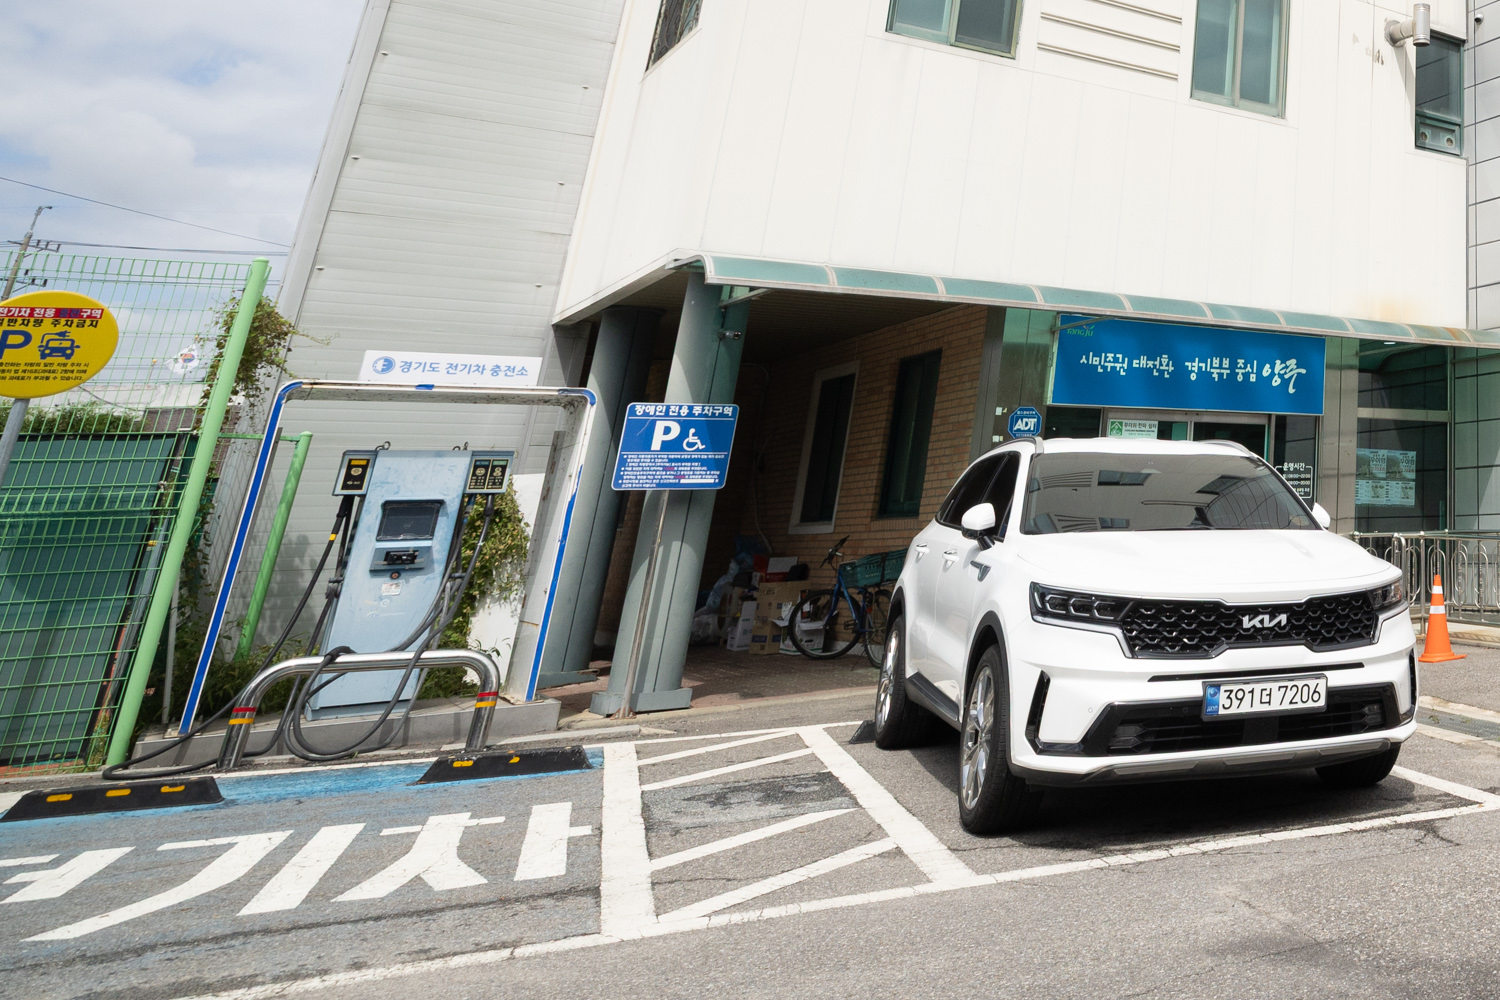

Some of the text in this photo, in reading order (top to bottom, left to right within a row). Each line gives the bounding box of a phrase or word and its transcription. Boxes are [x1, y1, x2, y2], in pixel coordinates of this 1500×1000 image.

[0, 308, 30, 317] 전기차
[33, 308, 55, 317] 전용
[51, 319, 99, 328] 주차금지
[0, 329, 33, 360] P
[399, 360, 529, 377] 경기도 전기차 충전소
[1080, 352, 1307, 394] 시민주권 대전환 경기북부 중심 양주
[635, 405, 733, 417] 장애인 전용 주차구역
[1013, 418, 1037, 431] ADT
[650, 420, 681, 451] P
[1283, 462, 1305, 471] 운영시간
[1242, 614, 1288, 628] KIA
[1222, 682, 1321, 710] 391더 7206
